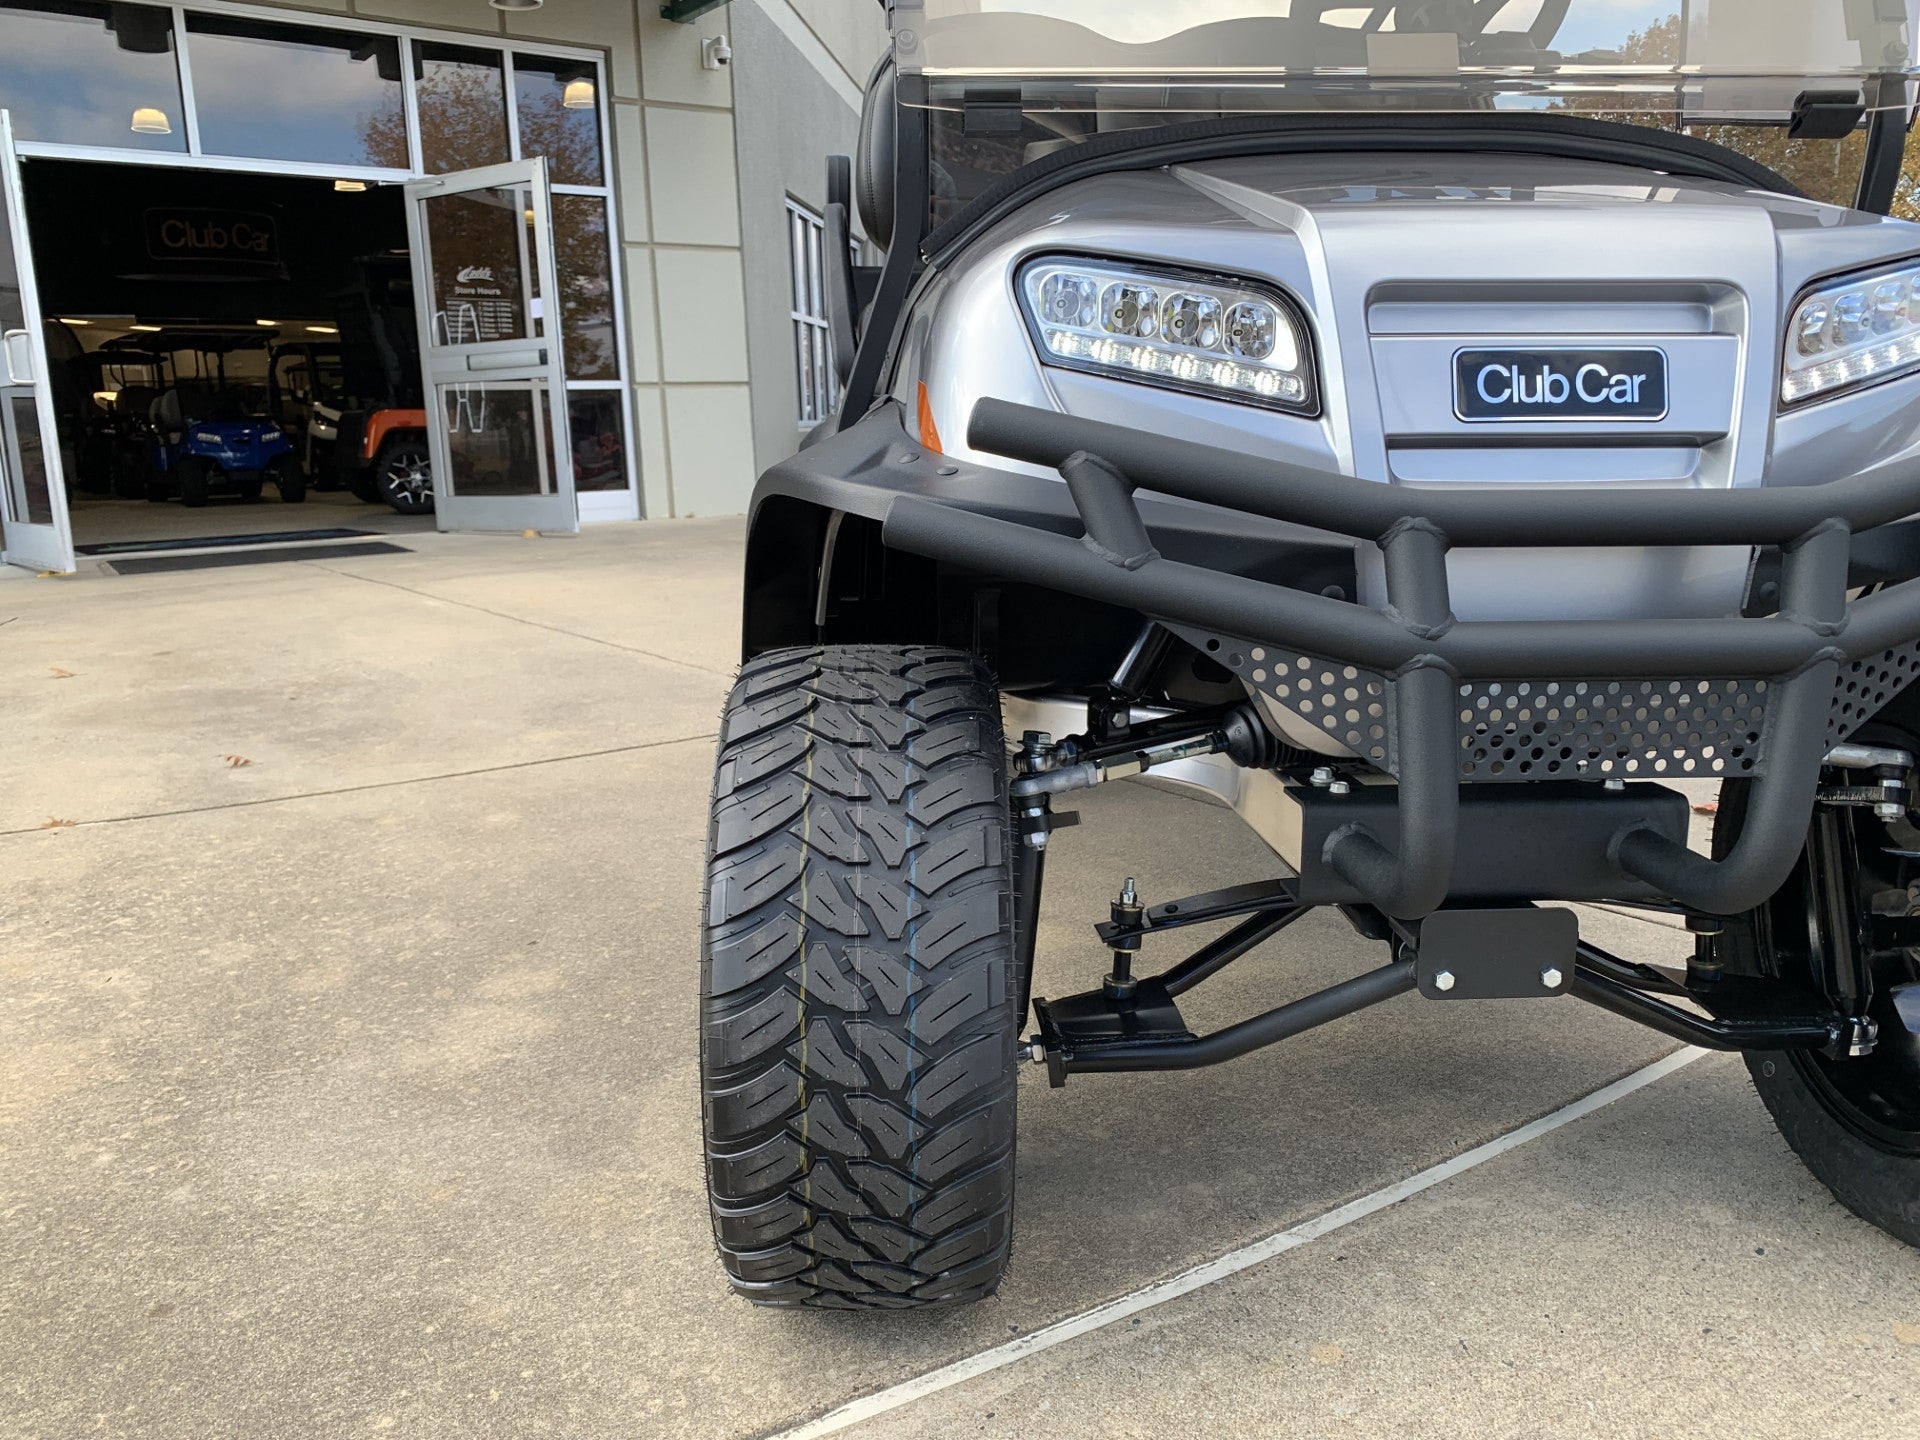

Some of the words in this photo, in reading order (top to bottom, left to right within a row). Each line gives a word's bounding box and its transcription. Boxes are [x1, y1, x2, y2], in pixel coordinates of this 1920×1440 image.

[161, 219, 227, 248] Club
[454, 286, 476, 296] Store
[477, 287, 501, 296] Hours
[1476, 364, 1570, 404] Club
[1575, 364, 1646, 404] Car
